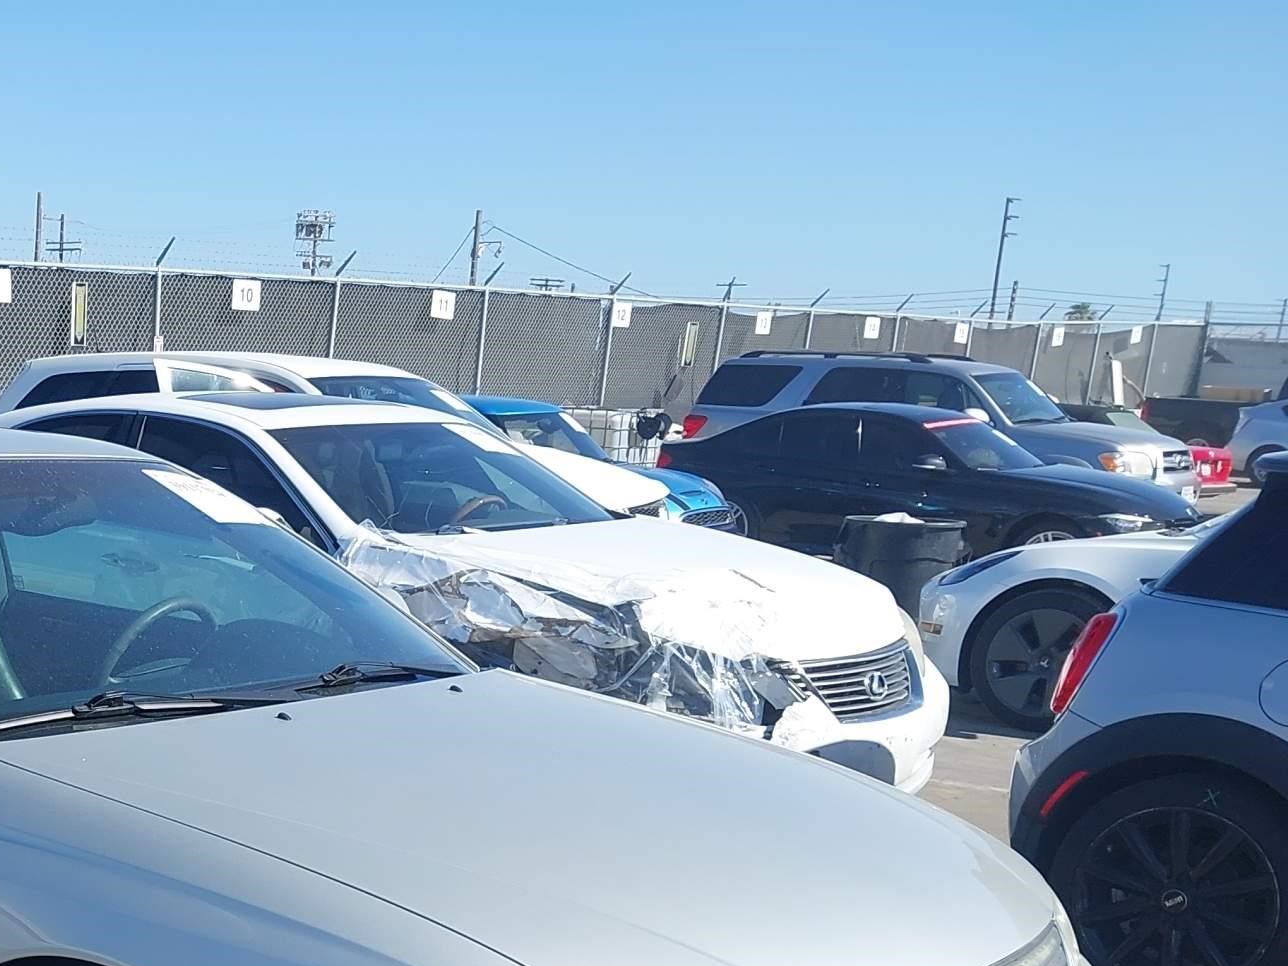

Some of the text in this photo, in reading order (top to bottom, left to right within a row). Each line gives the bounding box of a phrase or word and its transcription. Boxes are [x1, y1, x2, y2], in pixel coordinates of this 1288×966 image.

[240, 287, 253, 303] 10
[439, 297, 448, 312] 11
[617, 309, 626, 321] 12
